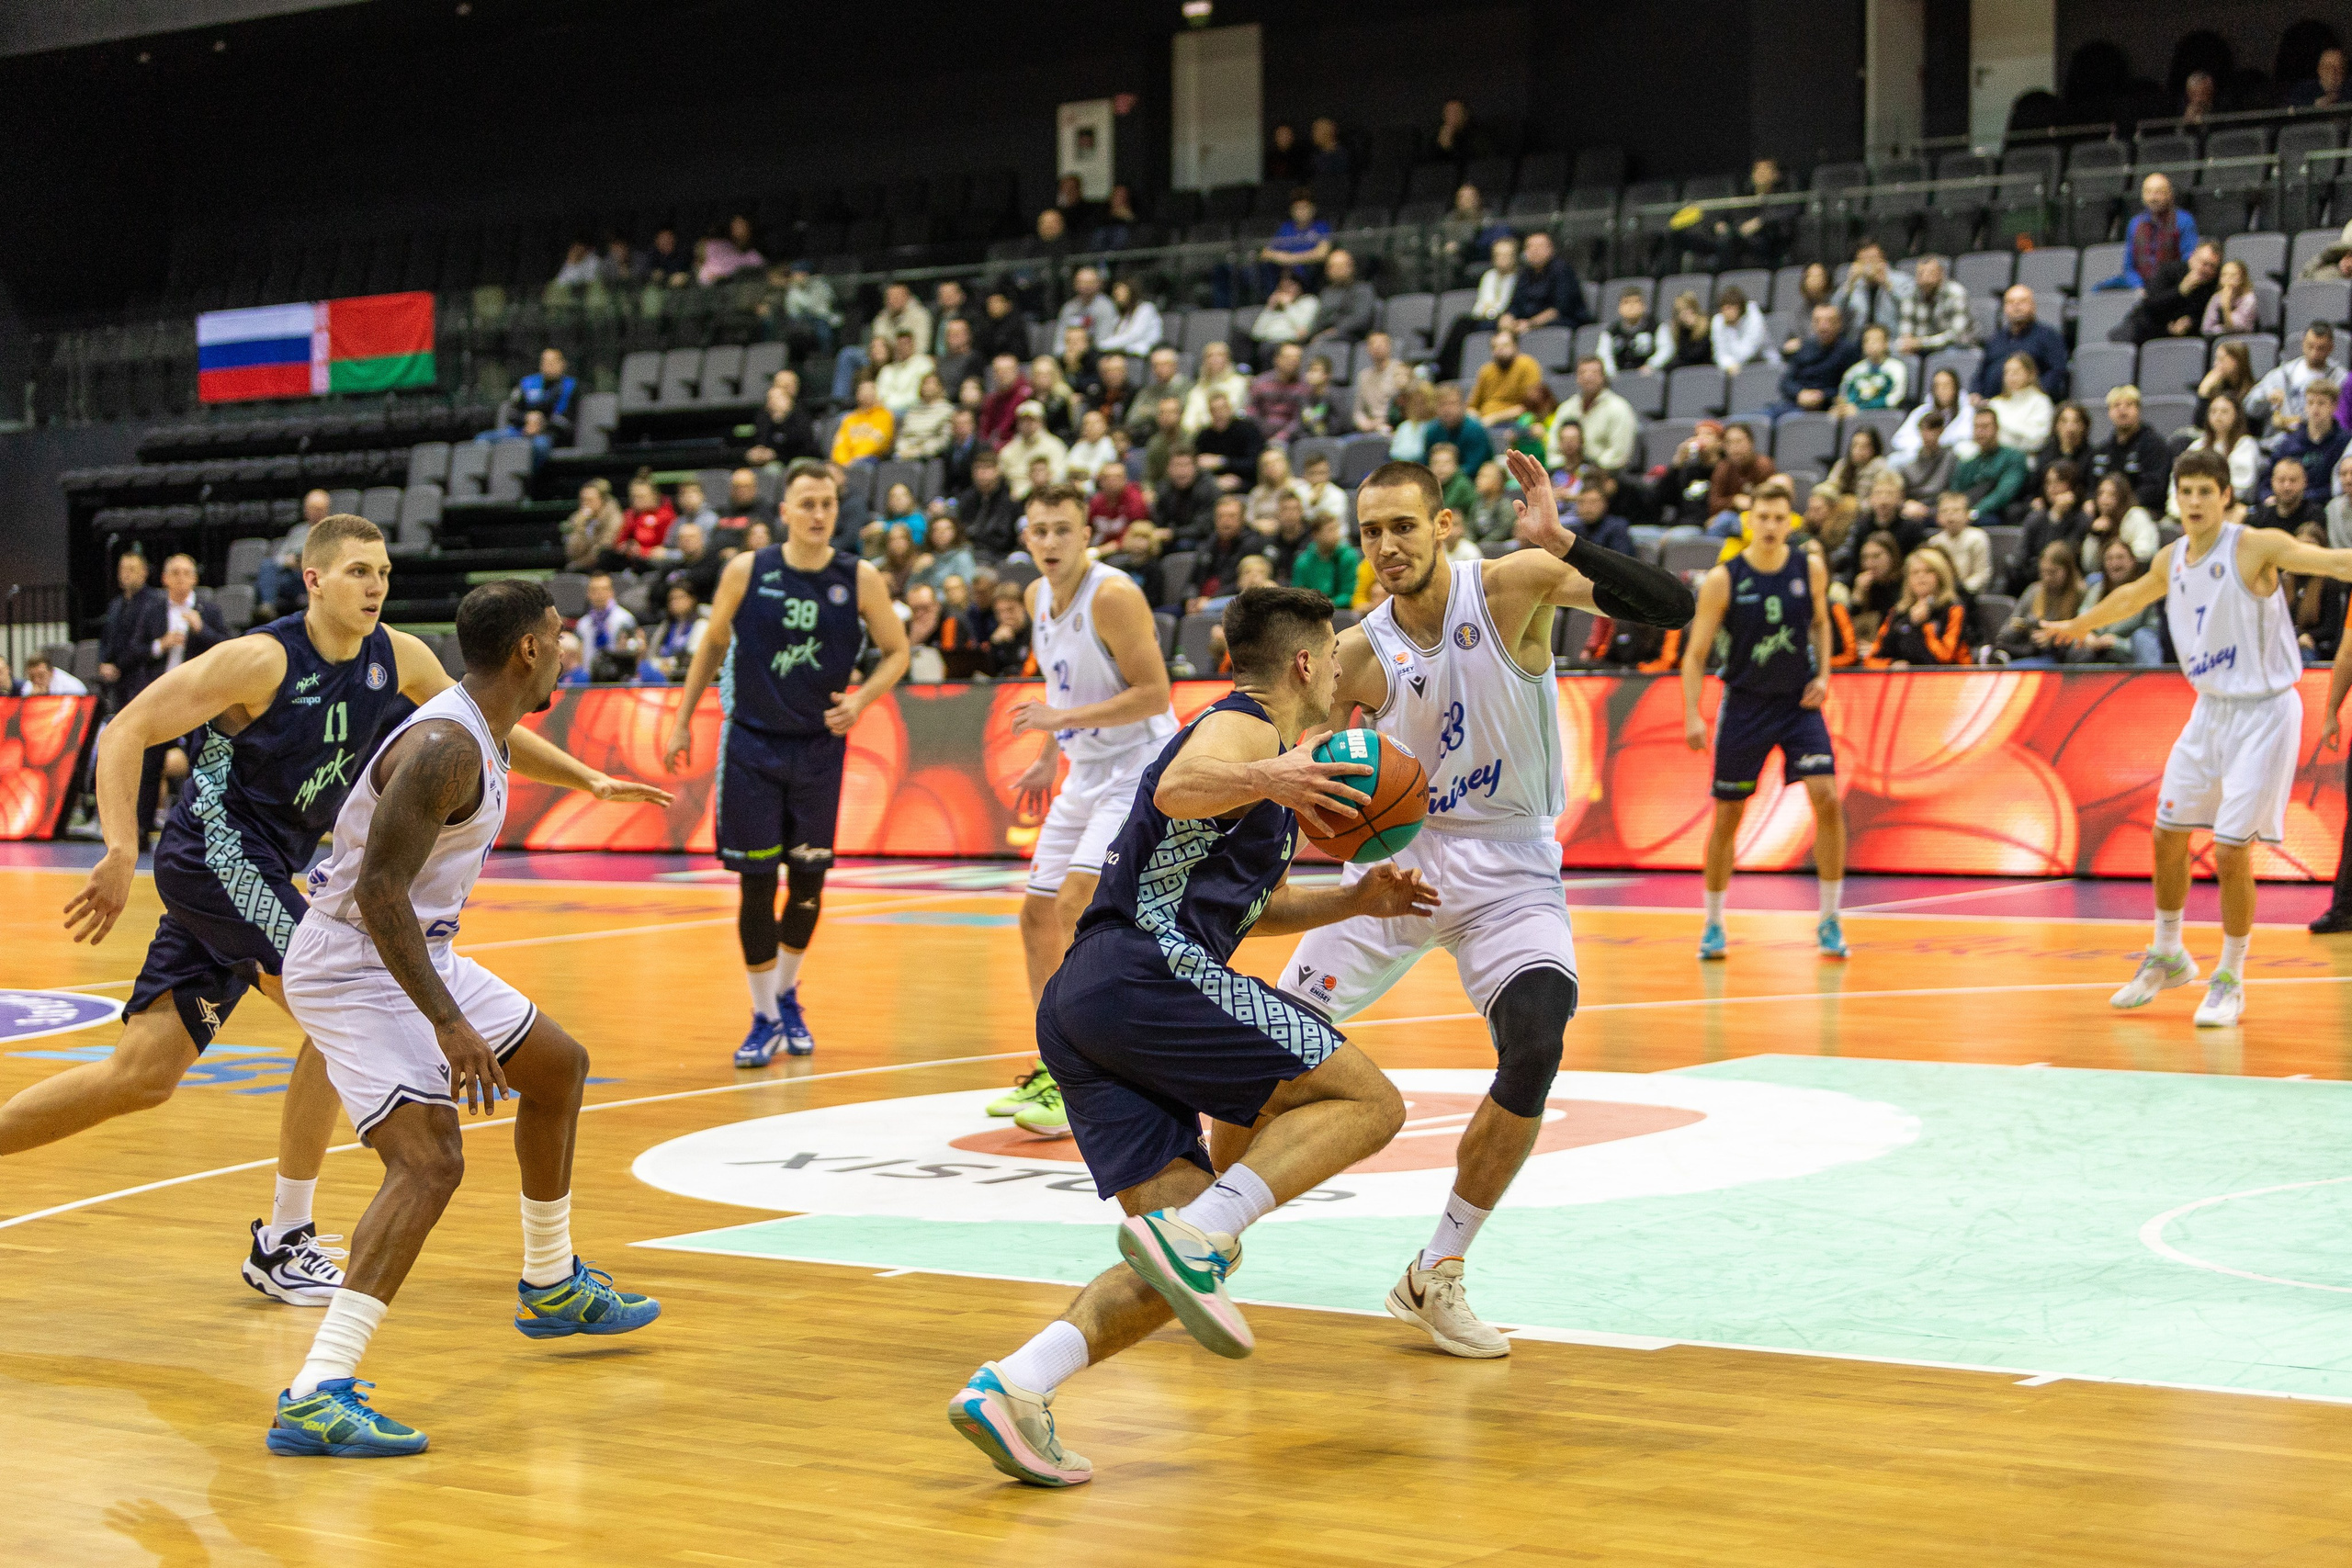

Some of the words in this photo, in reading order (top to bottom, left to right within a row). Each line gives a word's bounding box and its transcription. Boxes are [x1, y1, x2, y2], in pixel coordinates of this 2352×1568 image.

[782, 597, 819, 631] 38
[1764, 594, 1783, 625] 9
[2195, 605, 2207, 636] 7
[290, 695, 322, 706] empa
[323, 701, 348, 743] 11
[1309, 987, 1332, 1003] ENISEY
